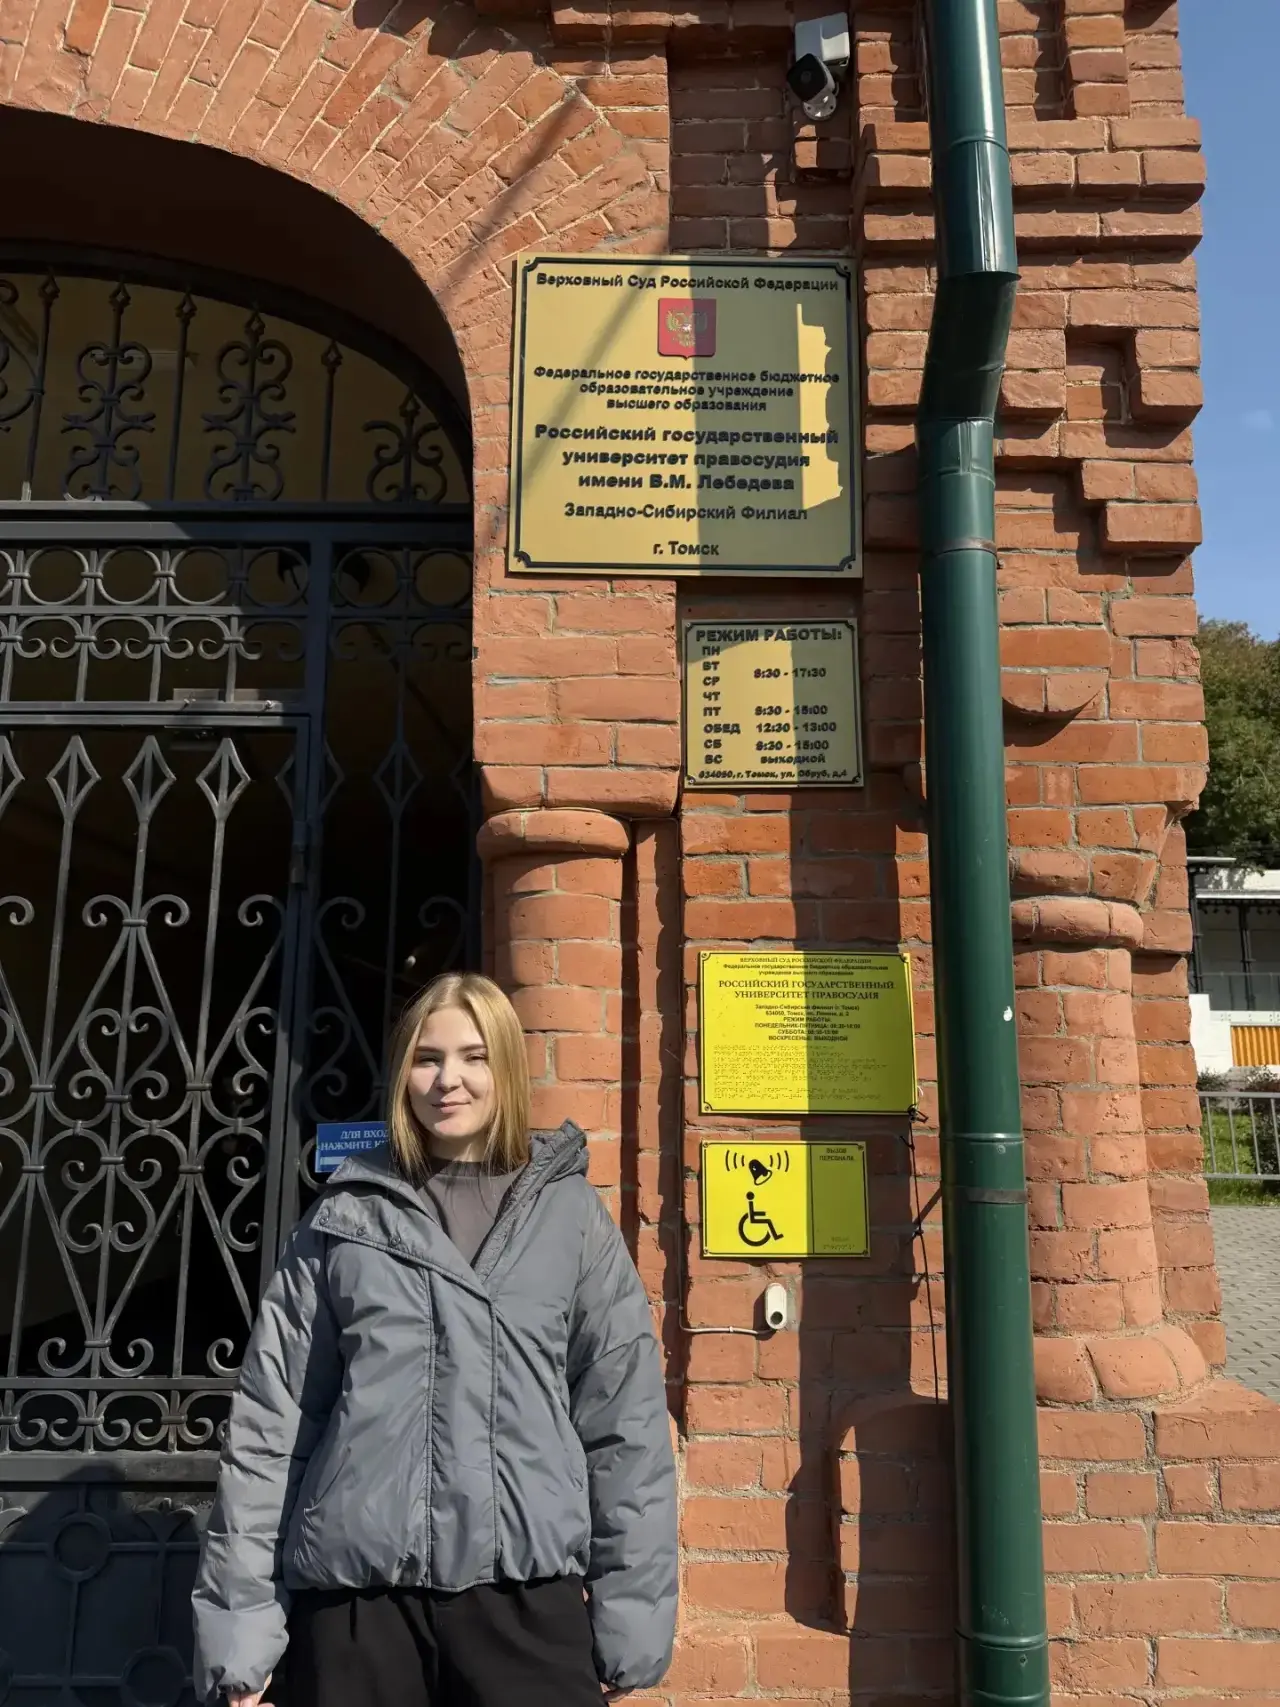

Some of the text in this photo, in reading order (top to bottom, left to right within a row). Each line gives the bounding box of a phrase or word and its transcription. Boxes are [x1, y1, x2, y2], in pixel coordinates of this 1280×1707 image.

[536, 273, 839, 292] Верховный Суд Российской Федерации
[534, 366, 839, 384] Федеральное государственное бюджетное
[579, 381, 794, 398] образовательное учреждение
[606, 399, 767, 413] высшего образования
[535, 424, 839, 446] Российский государственный
[562, 450, 810, 469] университет правосудия
[578, 474, 795, 492] имени В.М. Лебедева
[564, 502, 808, 521] Западно-Сибирский Филиал
[653, 541, 720, 556] г. Томск
[696, 628, 842, 642] РЕЖИМ РАБОТЫ:
[702, 646, 720, 656] ПН
[702, 661, 720, 671] ВТ
[753, 669, 781, 679] 8:30
[792, 668, 826, 678] 17:30
[702, 676, 720, 686] СР
[703, 691, 720, 701] ЧТ
[703, 707, 721, 717] ПТ
[755, 706, 782, 715] 8:30
[703, 723, 741, 735] ОБЕД
[756, 723, 790, 733] 12:30
[802, 722, 837, 732] 13:00
[703, 739, 722, 749] СБ
[756, 741, 783, 751] 8:30
[704, 753, 826, 765] ВС выходной
[719, 979, 894, 989] РОССИЙСКИЙ ГОСУДАРСТВЕННЫЙ
[734, 990, 879, 1000] УНИВЕРСИТЕТ ПРАВОСУДИЯ
[341, 1130, 361, 1139] ДЛЯ
[321, 1140, 372, 1150] НАЖМИТЕ
